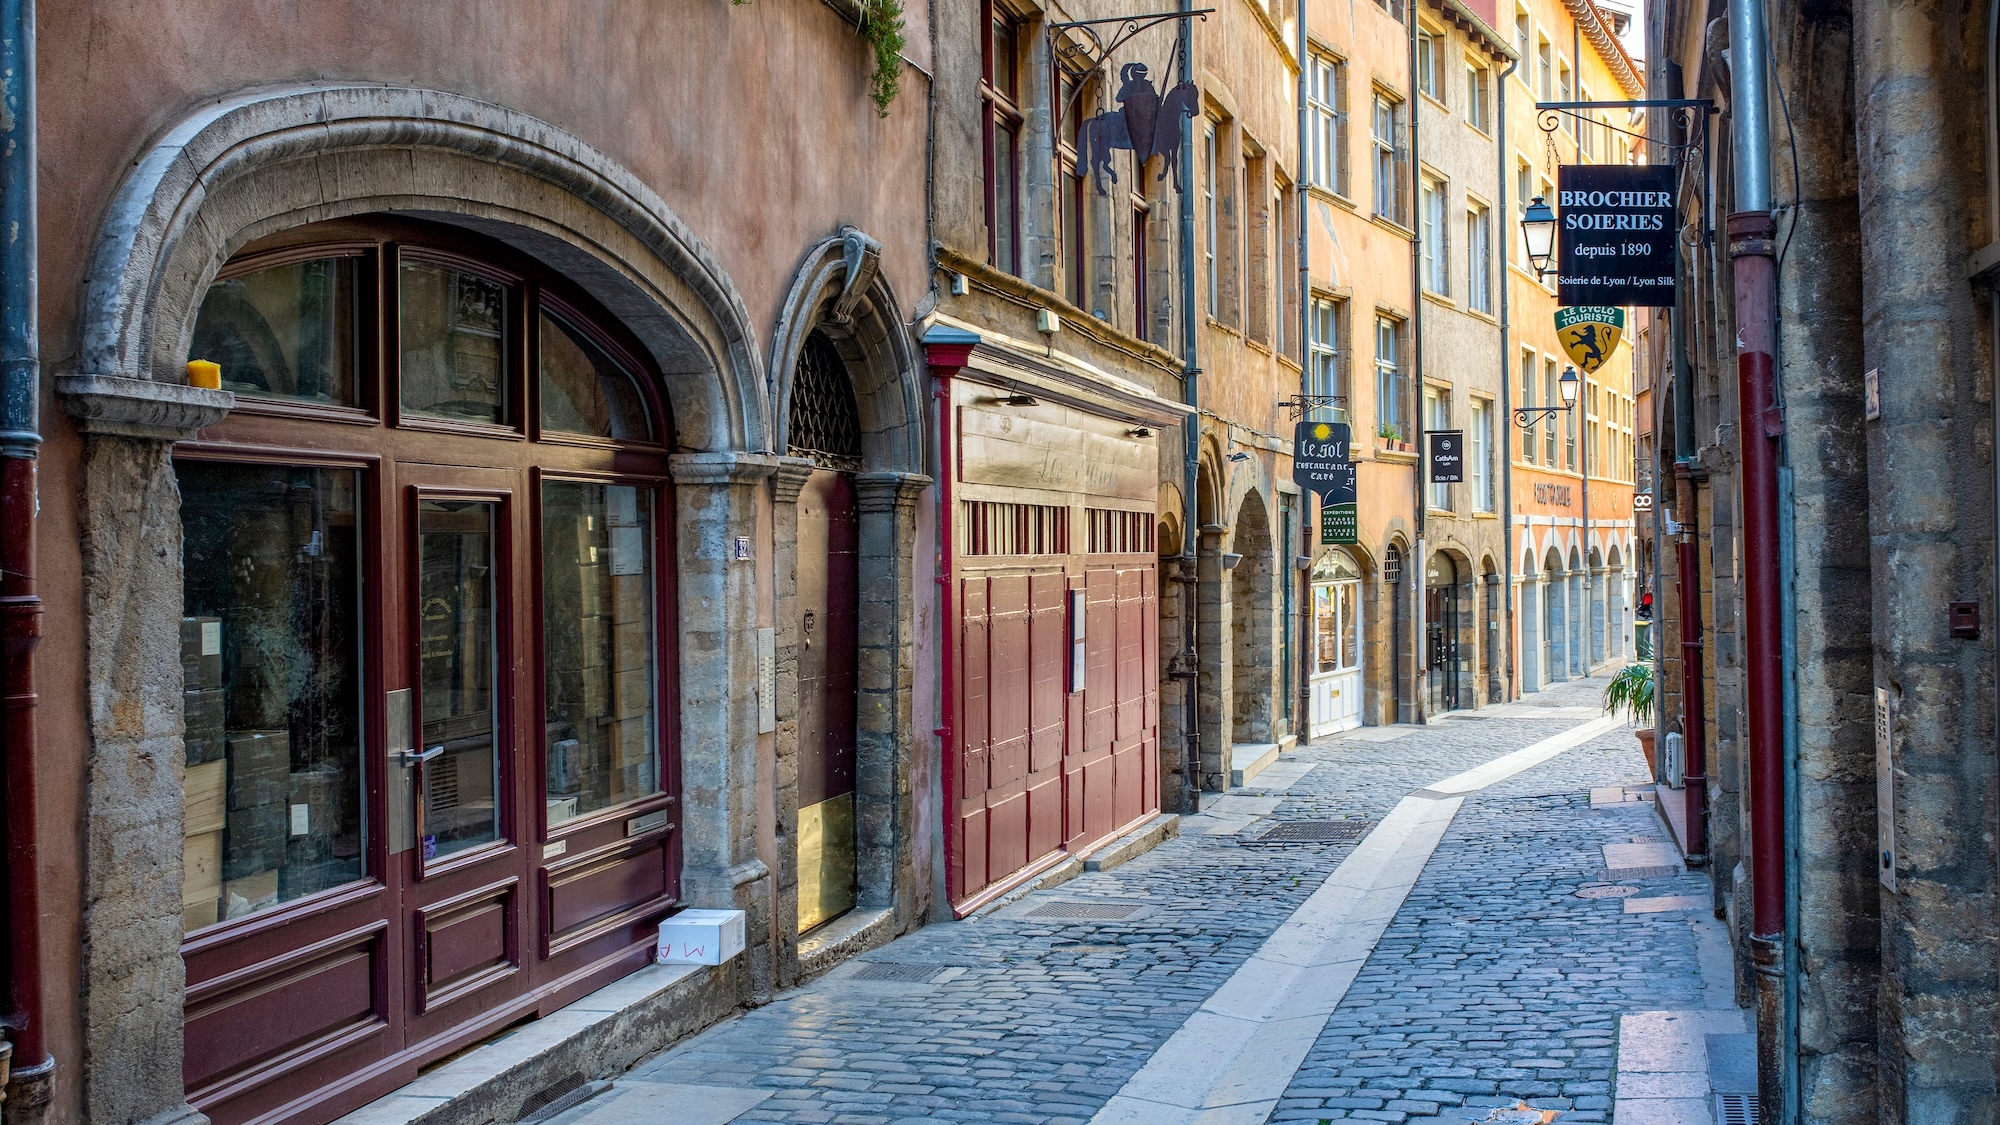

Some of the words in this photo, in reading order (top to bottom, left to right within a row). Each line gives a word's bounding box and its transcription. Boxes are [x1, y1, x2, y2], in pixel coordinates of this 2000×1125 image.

[1560, 191, 1672, 207] BROCHIER
[1566, 214, 1663, 230] SOIERIES
[1575, 243, 1615, 259] depuis
[1620, 243, 1651, 256] 1890
[1559, 276, 1588, 285] Soierie
[1590, 276, 1601, 285] de
[1603, 276, 1625, 287] Lyon
[1633, 277, 1655, 288] Lyon
[1657, 276, 1675, 286] Silk
[1562, 312, 1615, 326] TOURISTE
[1563, 308, 1576, 317] LE
[1578, 306, 1615, 316] CYCLO
